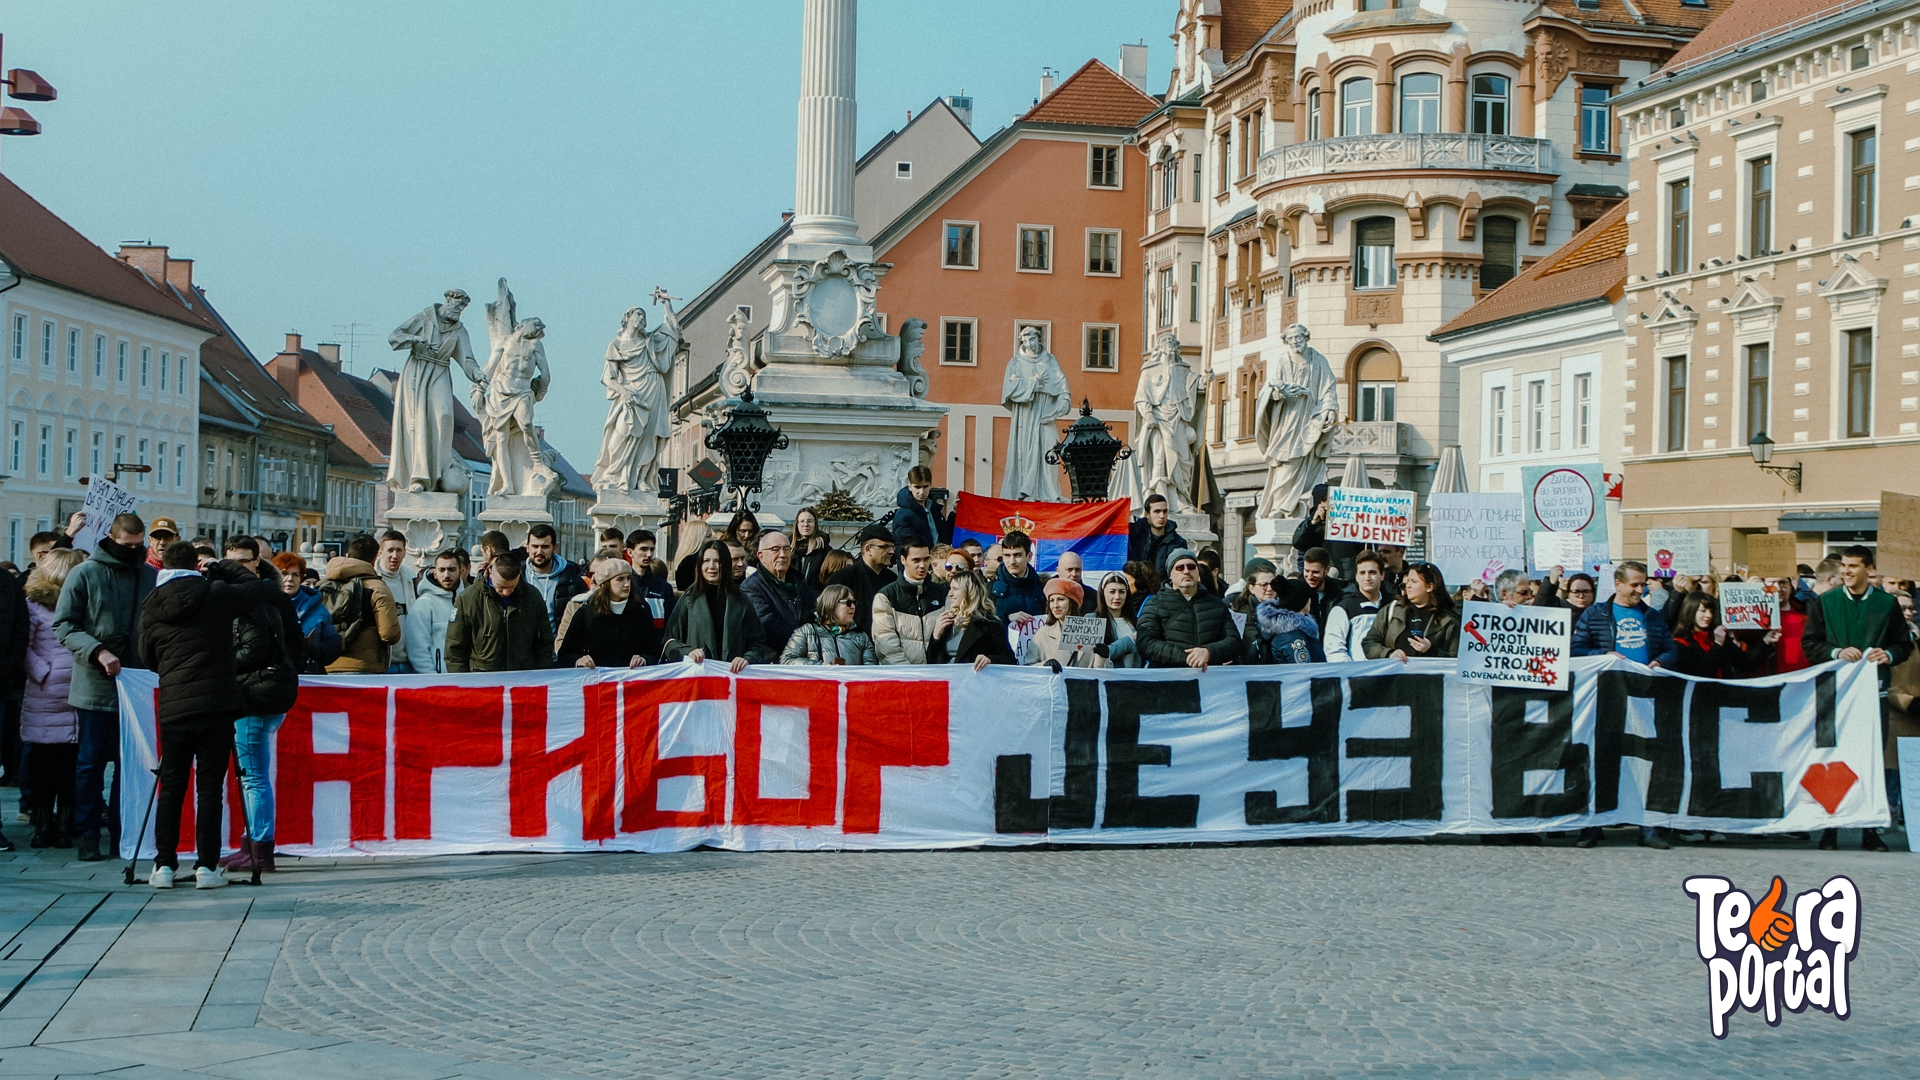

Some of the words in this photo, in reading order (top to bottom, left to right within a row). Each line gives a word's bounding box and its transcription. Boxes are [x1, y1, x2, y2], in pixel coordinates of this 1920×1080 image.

[1540, 487, 1549, 496] su
[1349, 494, 1384, 504] TREBAJU
[1385, 497, 1411, 506] NAMA
[1575, 497, 1584, 505] su
[1355, 512, 1371, 524] MI
[1374, 514, 1409, 527] IMAMO
[1443, 525, 1479, 540] ТАМО
[1434, 545, 1471, 559] СТРАХ
[1066, 616, 1087, 625] TREBA
[1470, 613, 1565, 636] STROJNIKI
[1063, 625, 1084, 634] ZNAM
[1490, 632, 1527, 646] PROTI
[1467, 641, 1560, 657] POKVARJENEMU
[1484, 655, 1540, 671] STROJU
[1461, 670, 1515, 682] SLOVENAČKA
[994, 678, 1202, 834] ЈЕ
[1245, 673, 1445, 825] УЗ
